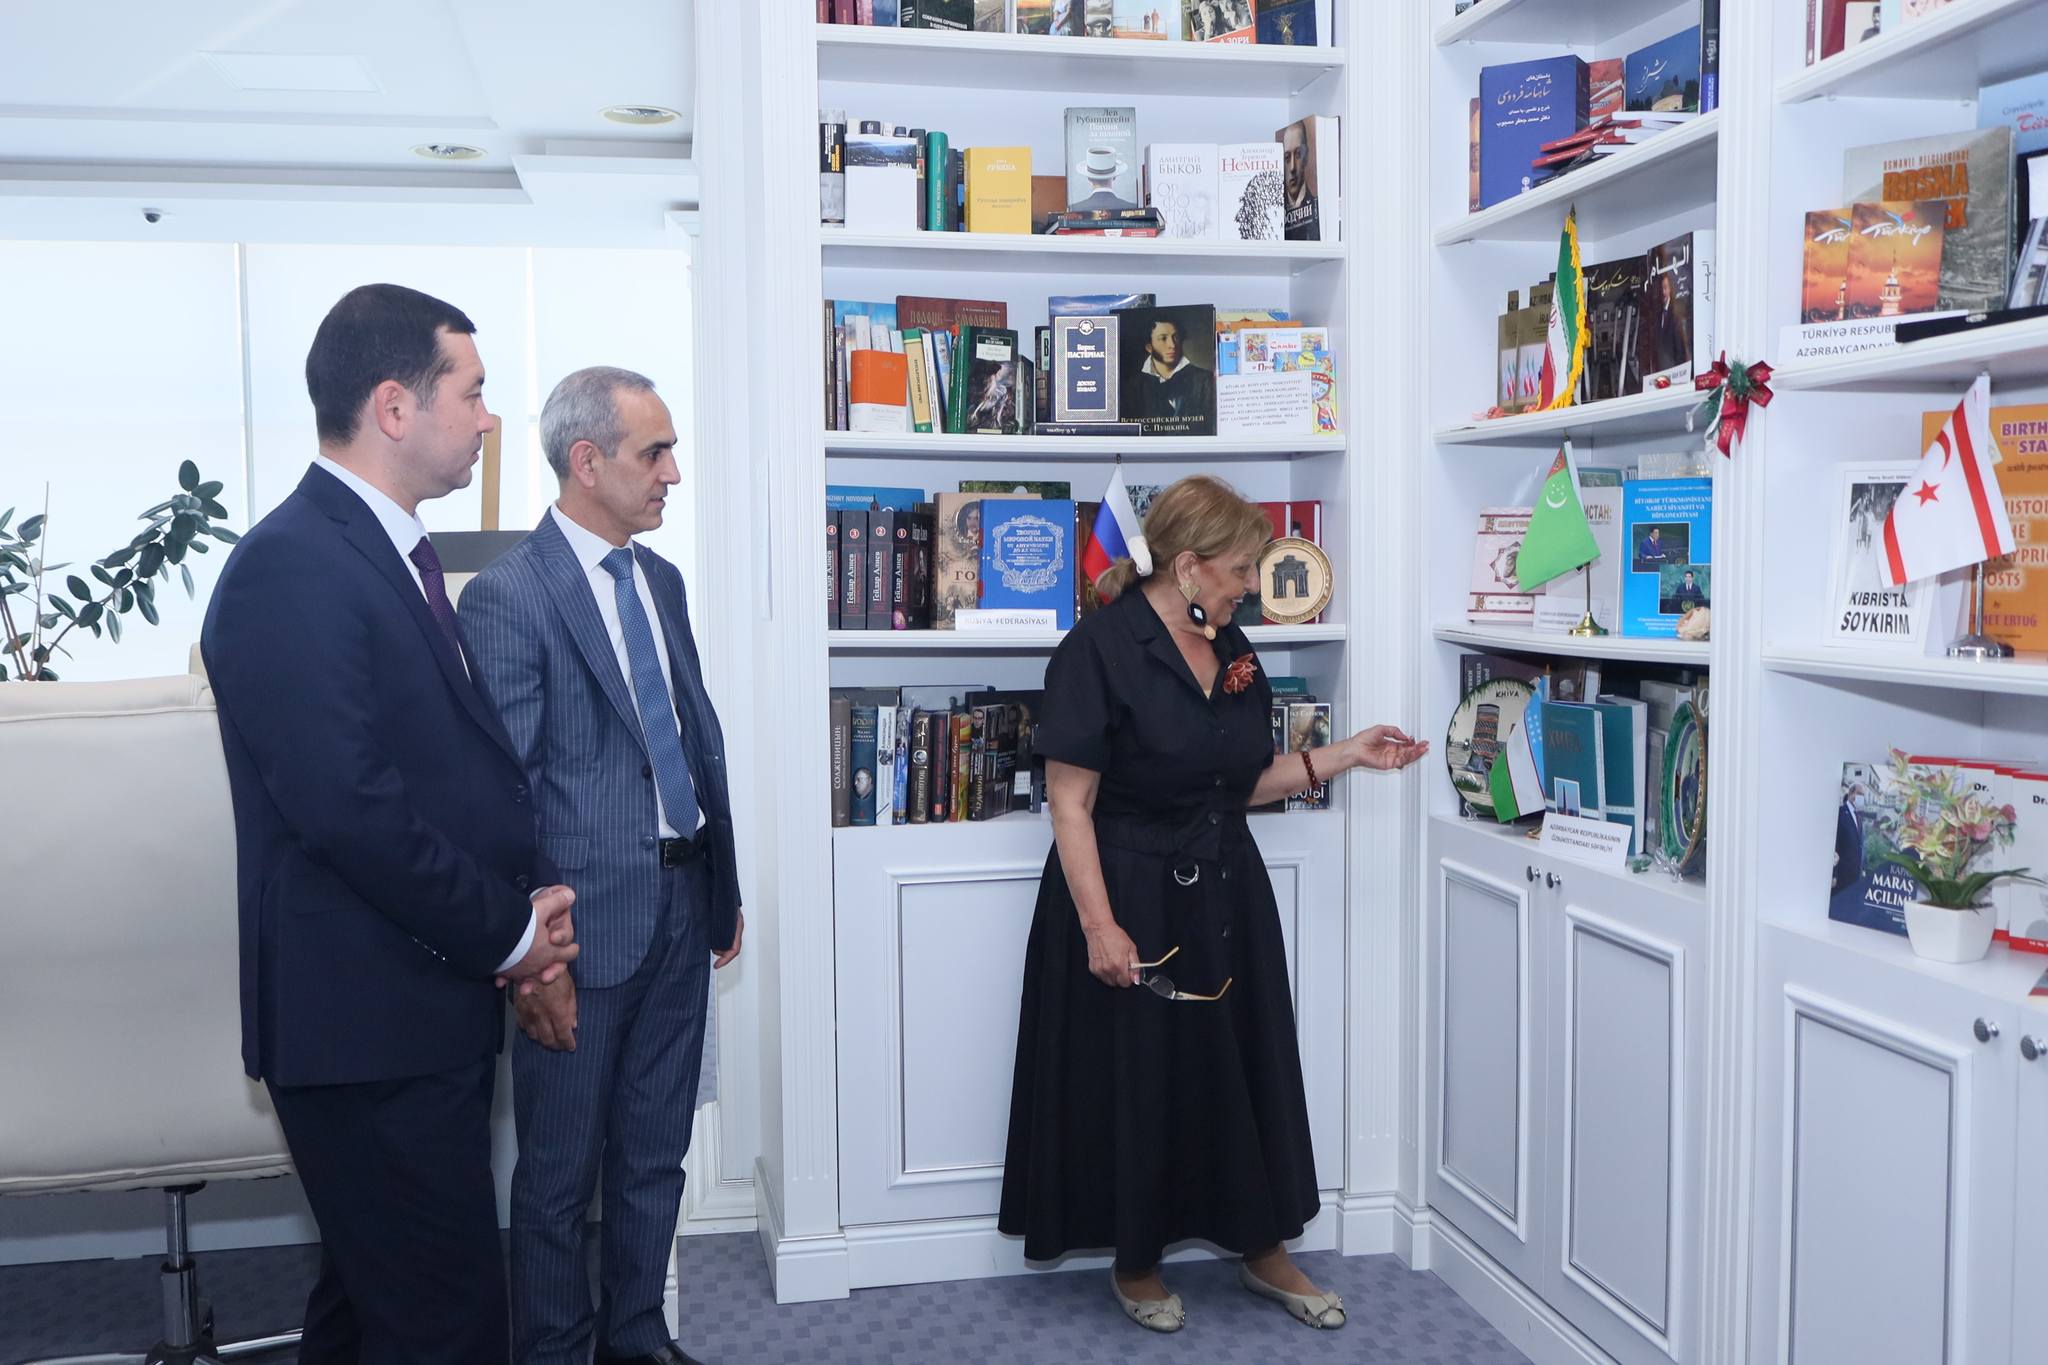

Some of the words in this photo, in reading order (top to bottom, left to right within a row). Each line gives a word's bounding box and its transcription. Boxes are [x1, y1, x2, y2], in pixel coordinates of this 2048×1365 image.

[1159, 164, 1202, 175] БЫКОВ
[1221, 158, 1280, 173] Немцы
[1861, 221, 1932, 246] Türkiye
[1802, 324, 1848, 340] TÜRKİYƏ
[2002, 421, 2048, 436] BIRTH
[873, 551, 881, 575] Алиев
[894, 553, 902, 576] Алиев
[847, 578, 855, 604] Гейдар
[872, 576, 881, 602] Гейдар
[894, 577, 902, 603] Гейдар
[1848, 591, 1908, 608] KIBRIS'TA
[995, 616, 1048, 625] FEDERASİYASI
[1841, 611, 1911, 635] SOYKIRIM
[1495, 689, 1520, 699] KHIVA
[1973, 783, 1989, 792] Dr.
[2033, 795, 2048, 805] Dr.
[1872, 873, 1914, 894] MARAŞ
